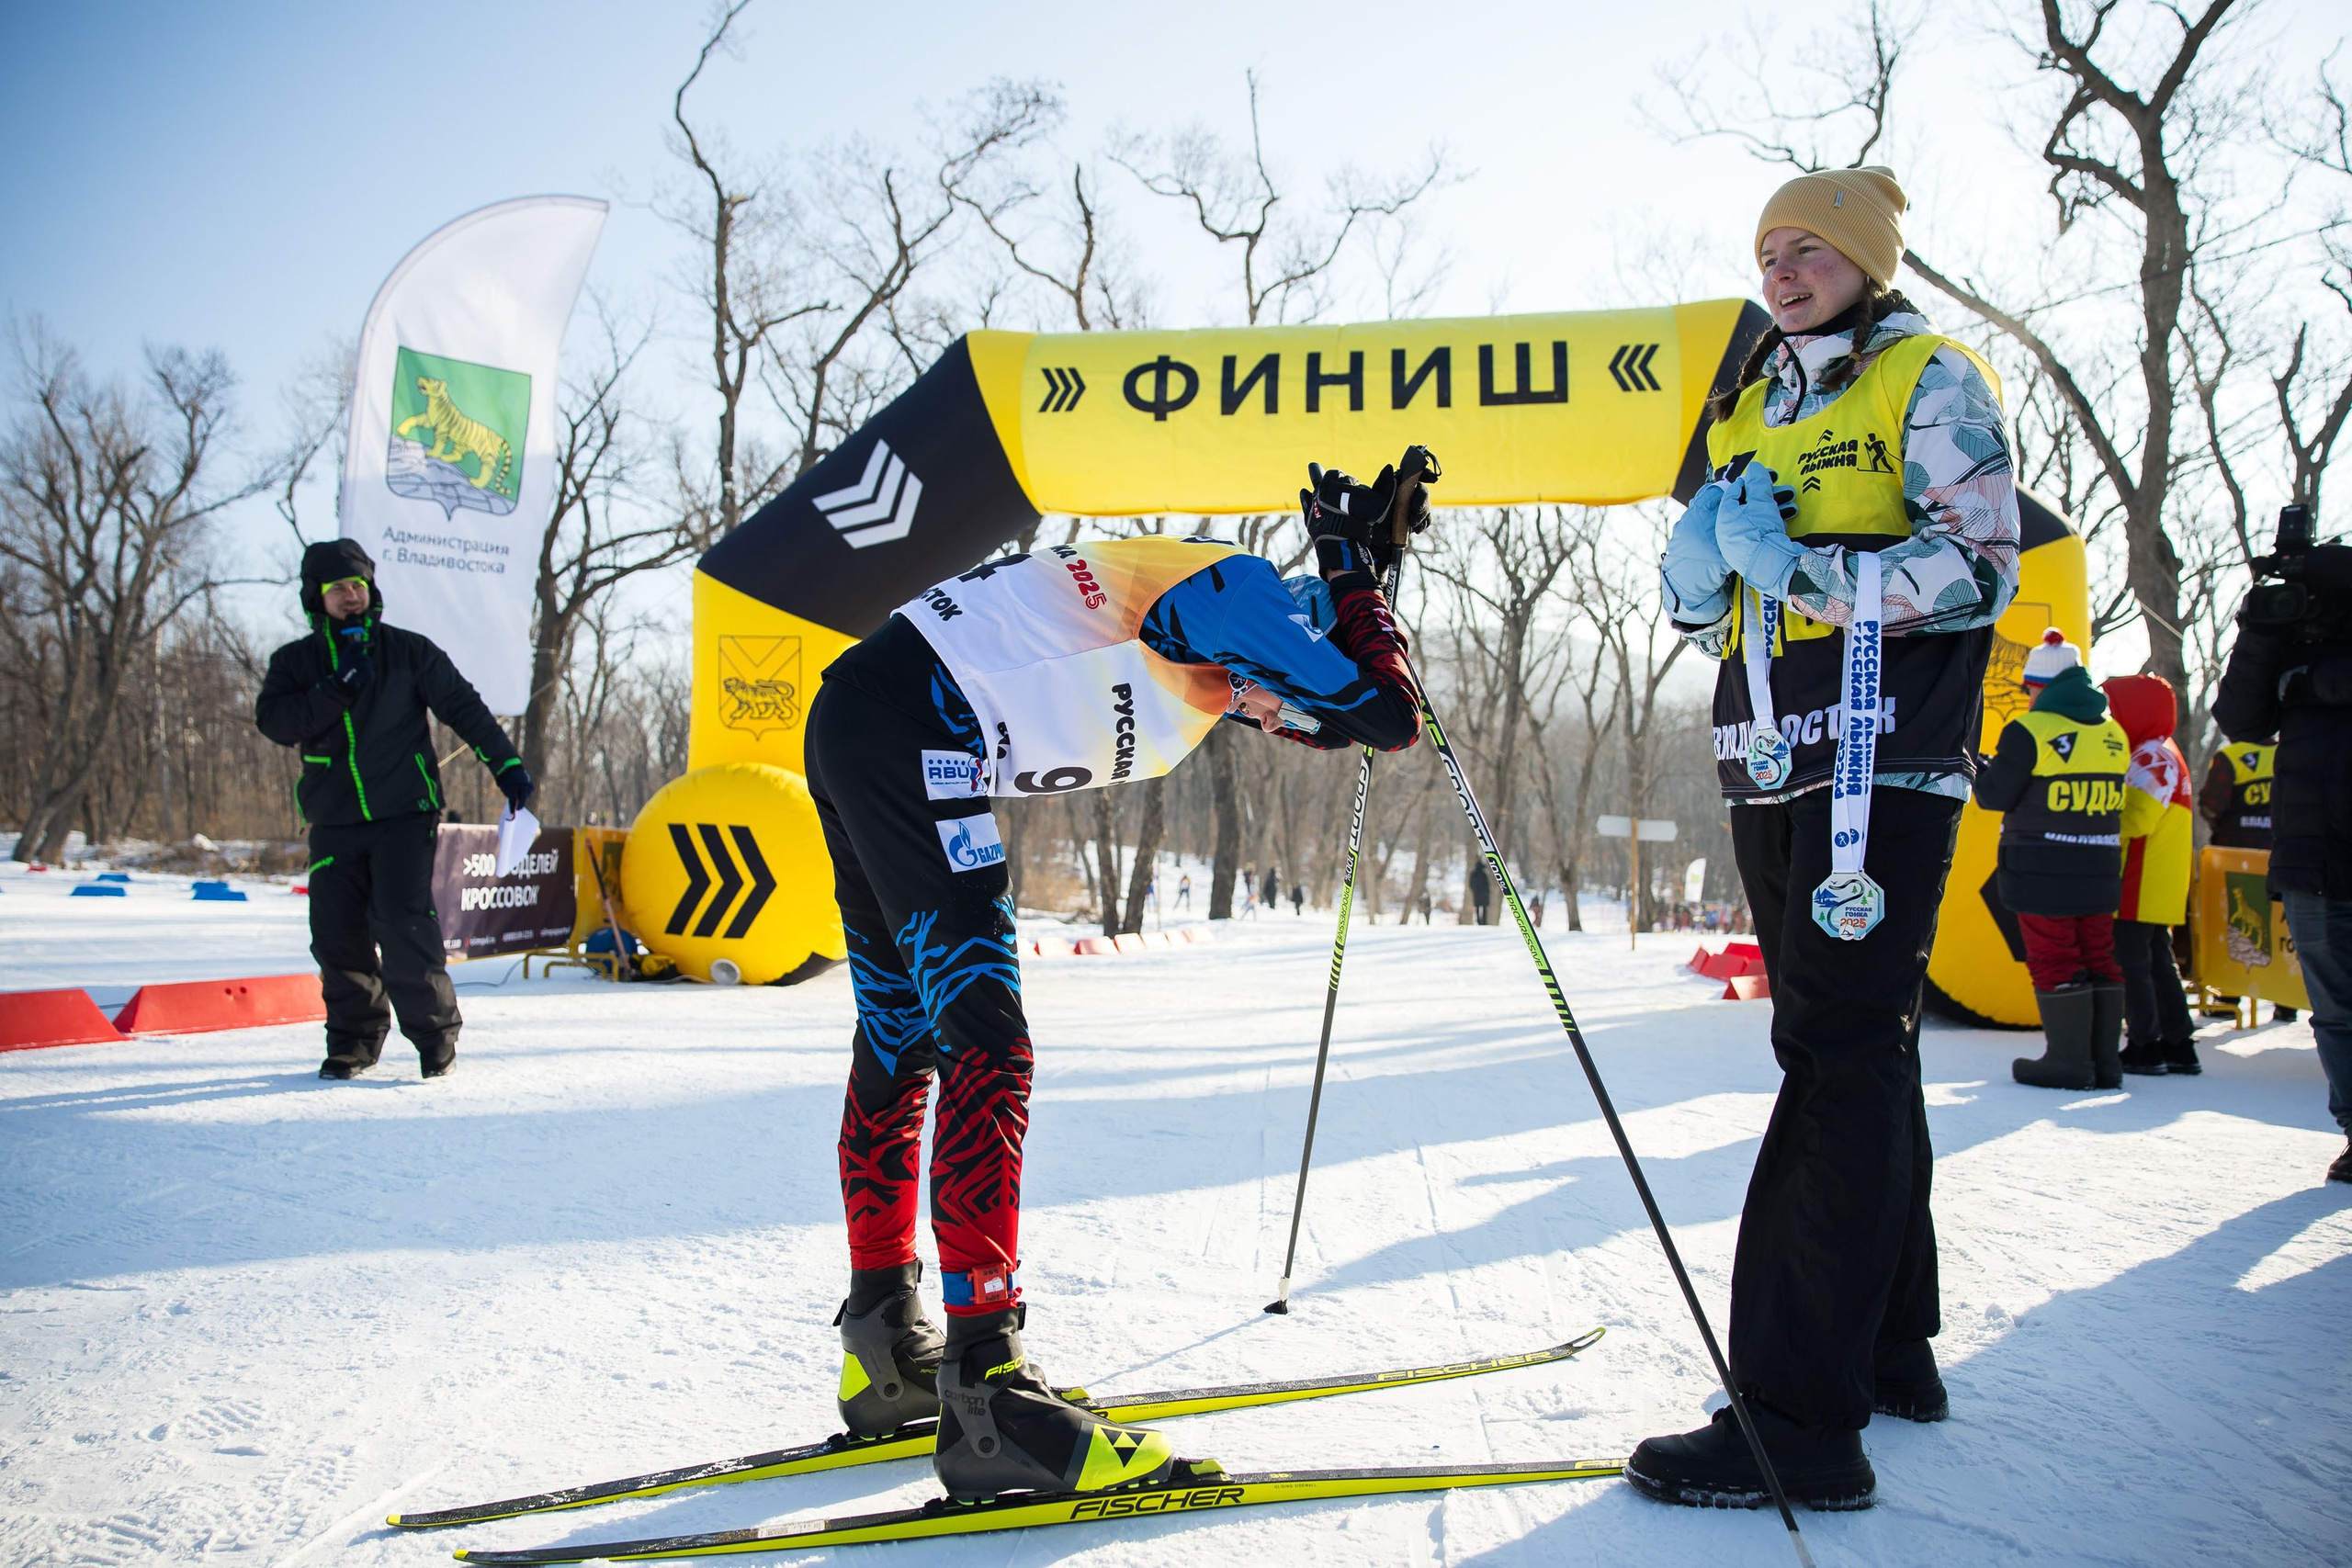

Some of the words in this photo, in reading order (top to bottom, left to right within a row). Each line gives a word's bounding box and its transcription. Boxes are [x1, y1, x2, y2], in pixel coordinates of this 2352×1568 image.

[1123, 340, 1568, 422] ФИНИШ
[1797, 439, 1858, 464] РУССКАЯ
[1800, 453, 1857, 476] ЛЫЖНЯ
[382, 525, 510, 556] Администрация
[382, 547, 392, 562] г.
[397, 547, 505, 574] Владивостока
[1066, 559, 1107, 610] 2025
[1863, 620, 1879, 710] РУССКАЯ
[1112, 682, 1136, 780] РУССКАЯ
[1846, 716, 1863, 795] ЛЫЖНЯ
[928, 766, 969, 779] RBU
[1755, 770, 1772, 781] 2025
[2244, 781, 2271, 806] СУ
[463, 853, 496, 877] >500
[510, 848, 560, 879] ОДЕЛЕЙ
[1345, 854, 1354, 882] 100%
[1489, 860, 1508, 894] 100%
[461, 885, 540, 911] КРОССОВОК
[1337, 886, 1350, 943] PROGRESSIVE
[1840, 918, 1867, 929] 2025
[1507, 897, 1544, 967] PROGRESSIVE
[944, 1389, 985, 1406] carbon
[967, 1403, 986, 1416] lite
[1070, 1486, 1245, 1520] FISCHER
